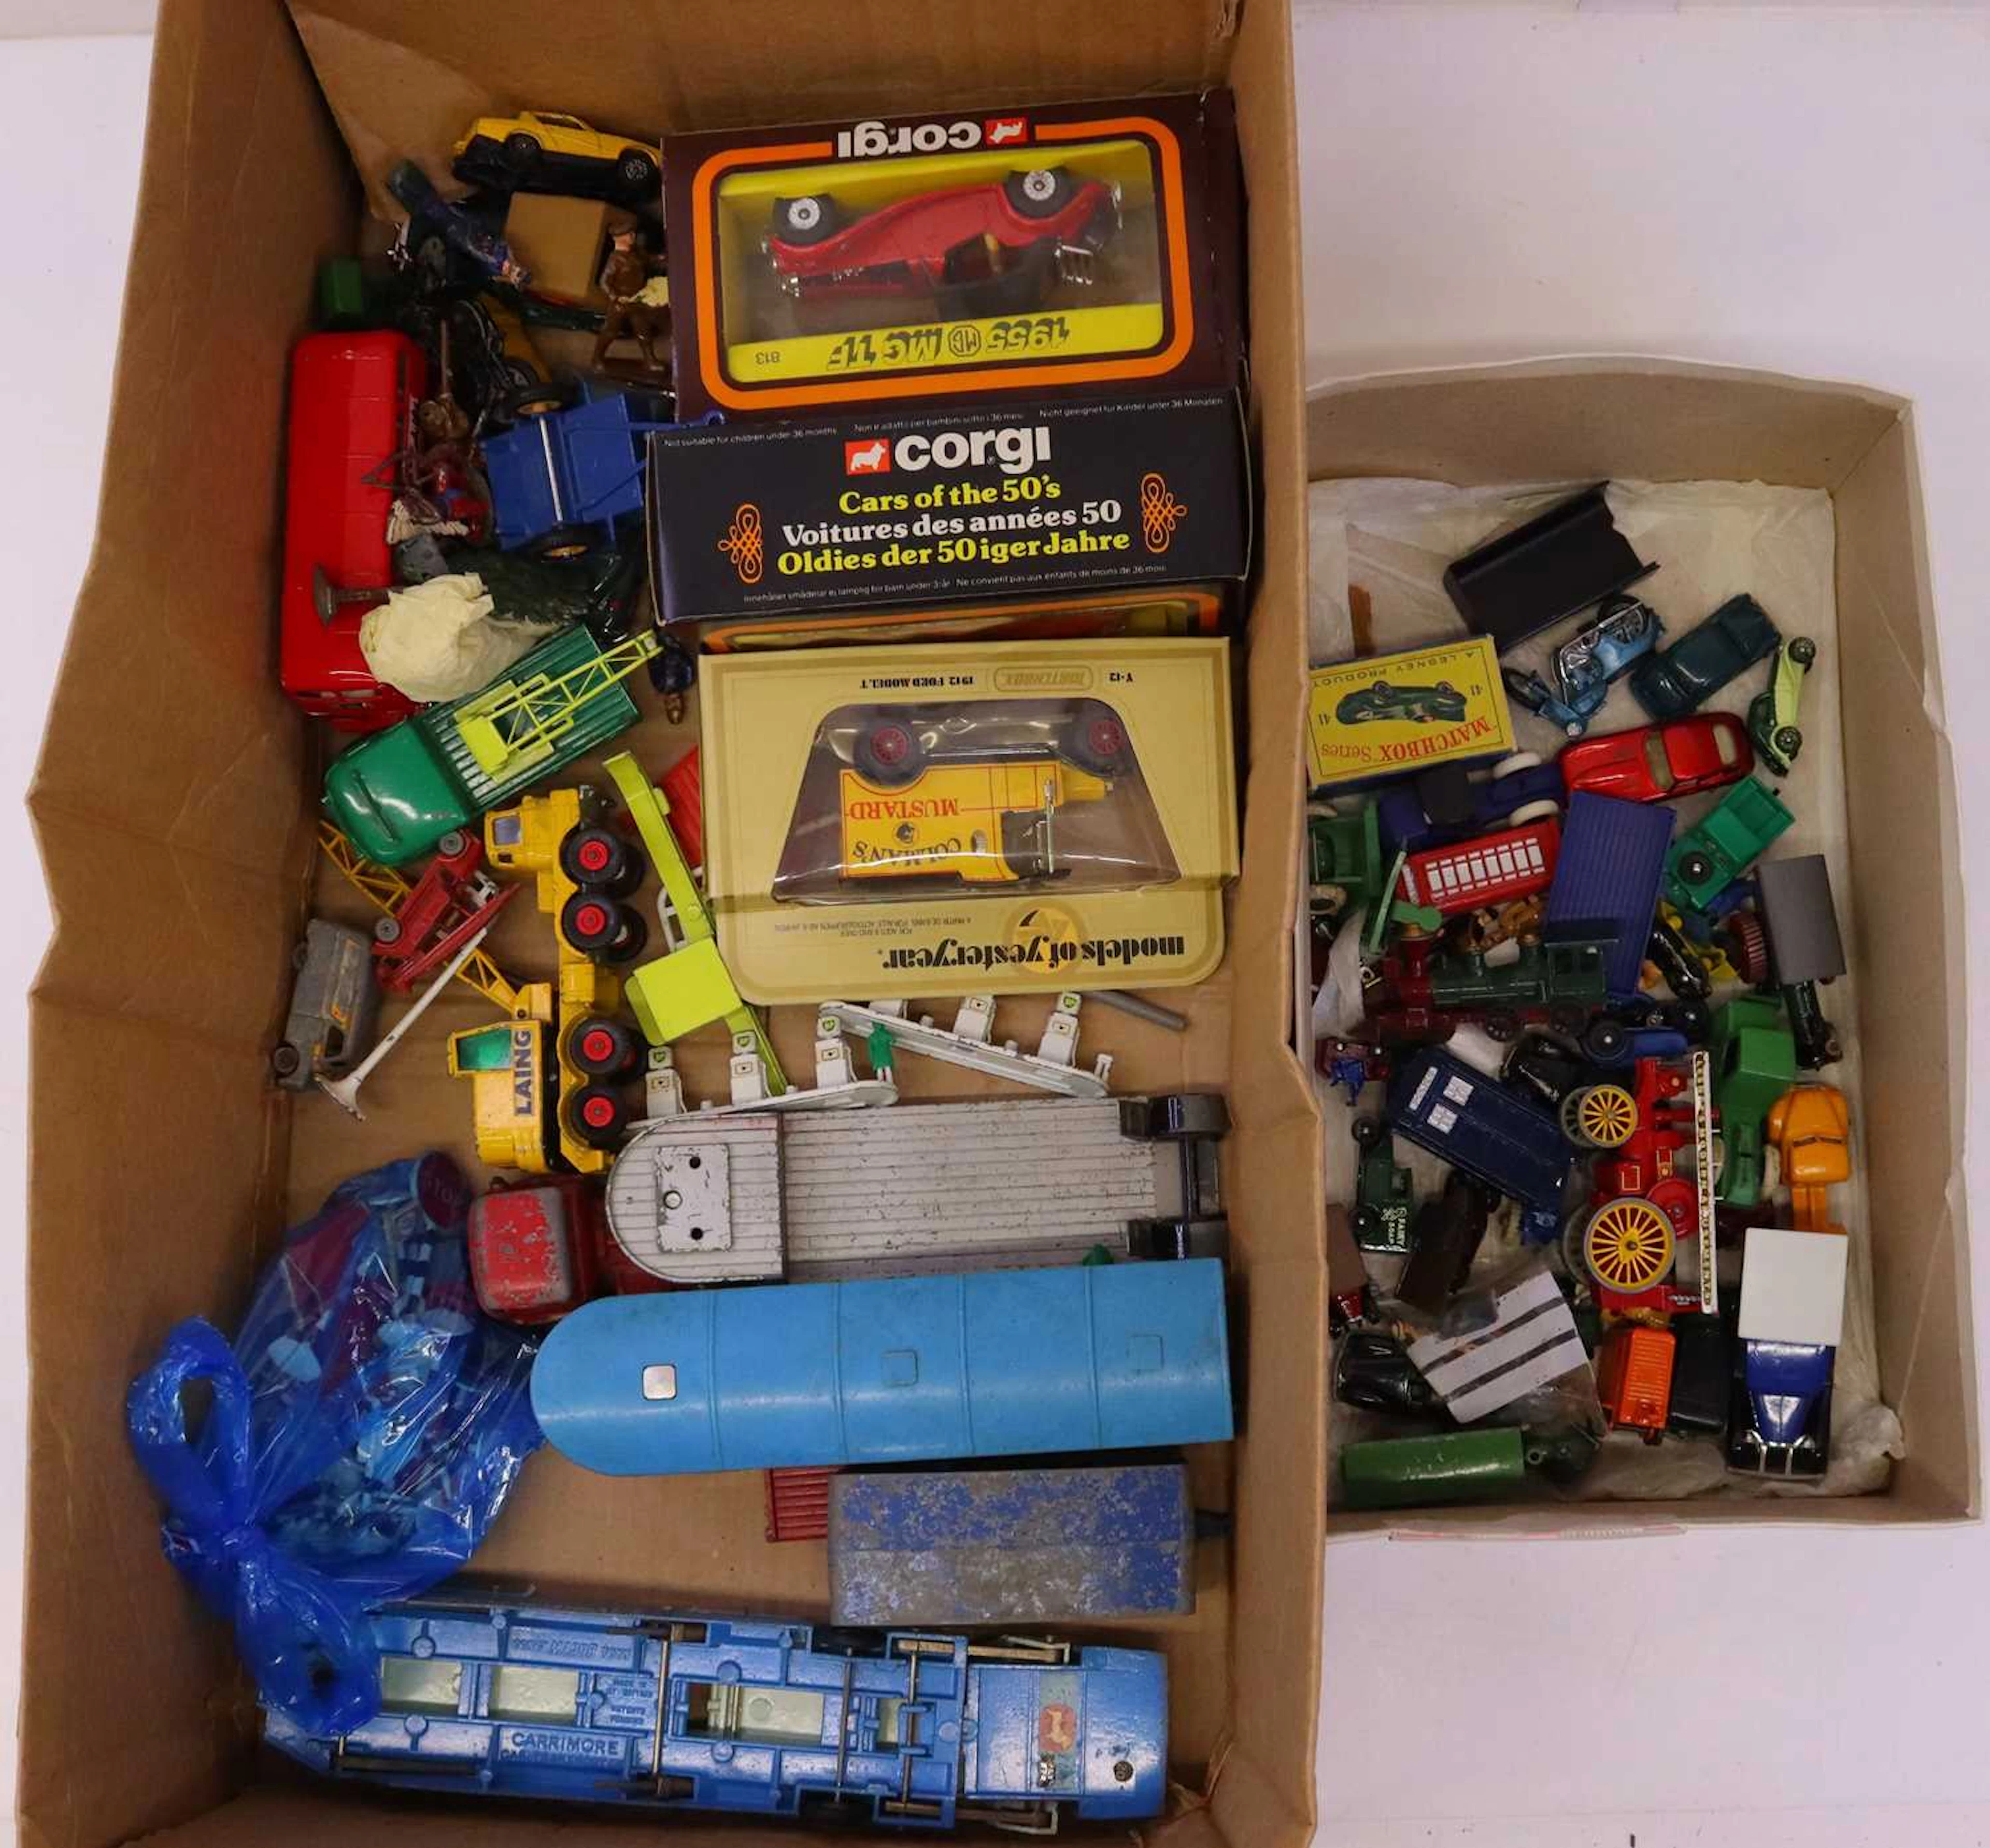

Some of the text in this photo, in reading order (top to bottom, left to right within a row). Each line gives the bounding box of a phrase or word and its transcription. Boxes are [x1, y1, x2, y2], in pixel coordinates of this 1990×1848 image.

[838, 121, 982, 158] corgi
[987, 317, 1070, 350] 1955
[755, 351, 780, 364] 813
[894, 427, 1051, 474] corgi
[838, 490, 909, 515] Cars
[914, 485, 944, 508] of
[949, 481, 998, 504] the
[781, 500, 1122, 547] Voitures des années 50
[777, 548, 877, 575] Oldies
[882, 544, 933, 567] der
[912, 676, 945, 688] FORD
[1321, 717, 1494, 764] MATCHBOX Series
[850, 798, 959, 819] MUSTARD
[883, 934, 1185, 971] models of yesteryear
[515, 1030, 532, 1115] LAING
[511, 1732, 619, 1756] CARRIMORE
